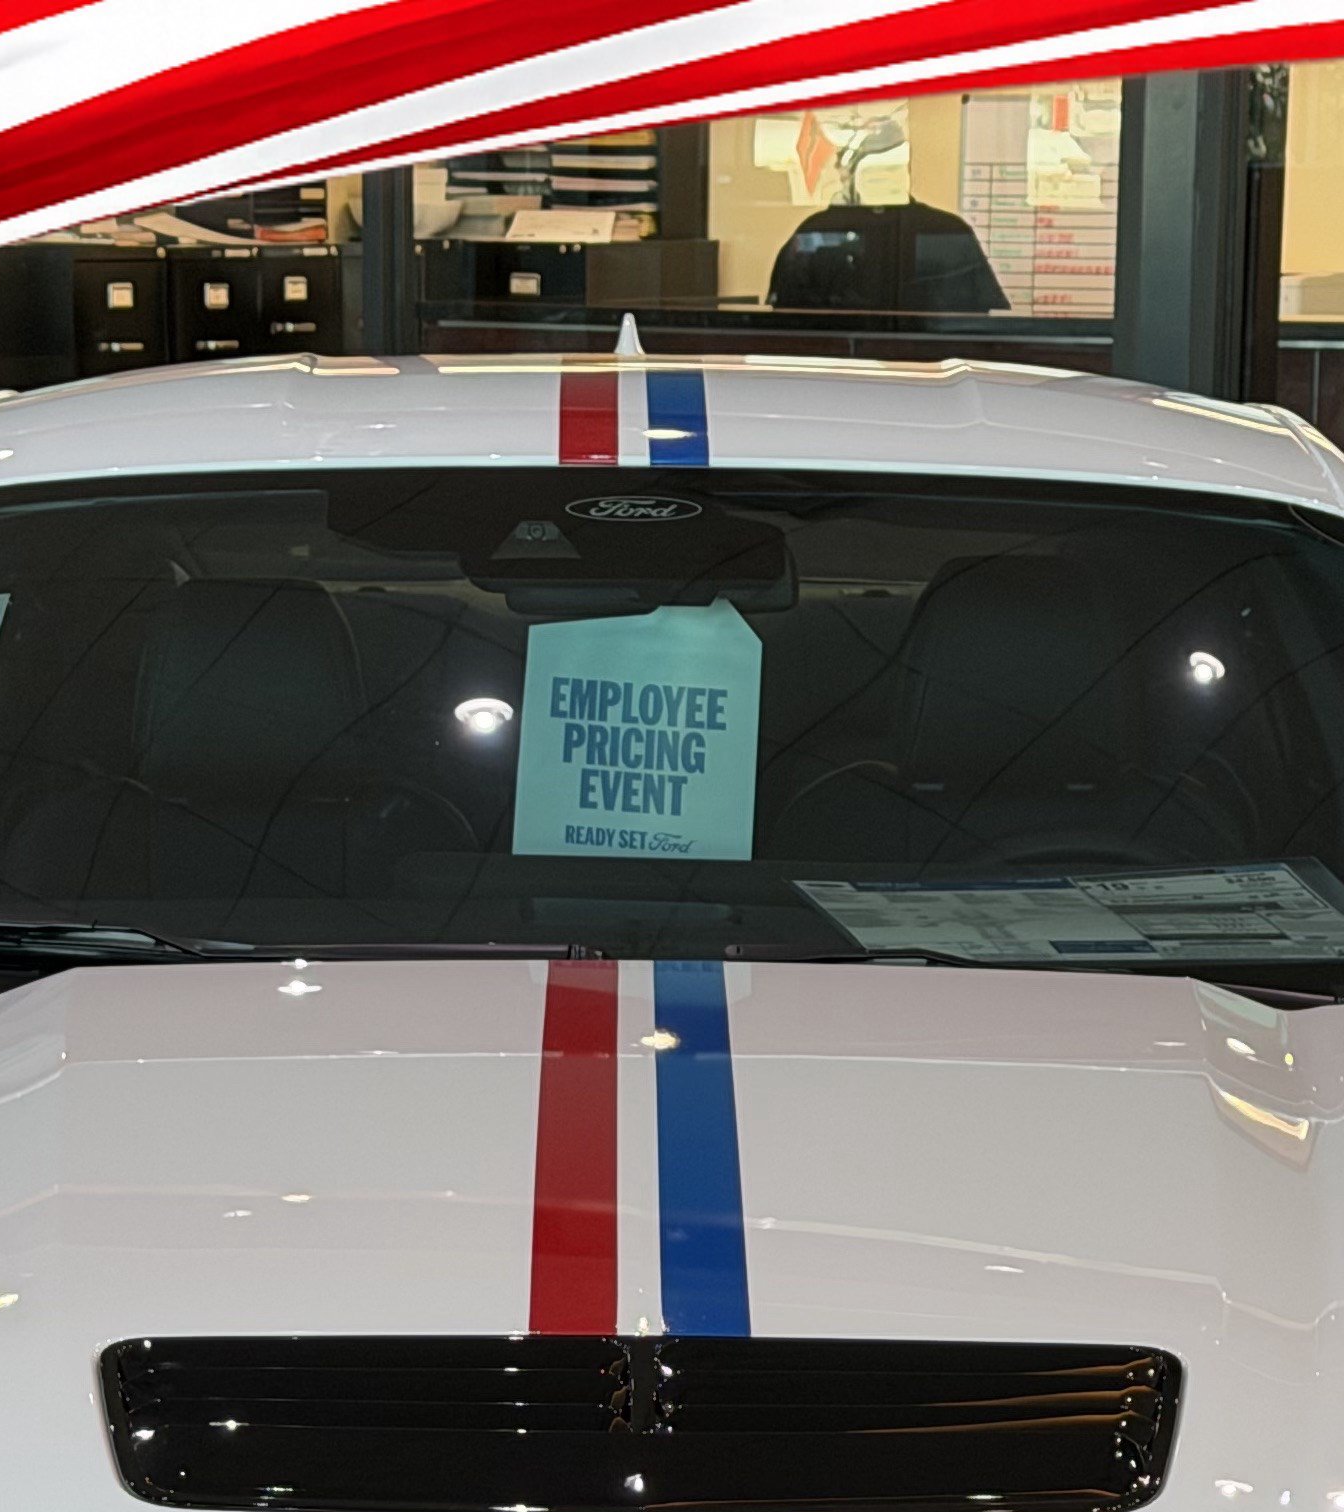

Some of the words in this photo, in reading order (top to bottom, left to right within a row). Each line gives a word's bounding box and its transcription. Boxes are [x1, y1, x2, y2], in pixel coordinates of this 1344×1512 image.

[589, 499, 678, 518] Ford
[549, 676, 729, 731] EMPLOYEE
[562, 723, 706, 774] PRICING
[579, 768, 688, 817] EVENT
[565, 825, 616, 847] READY
[618, 829, 648, 850] SET
[649, 832, 695, 854] Ford
